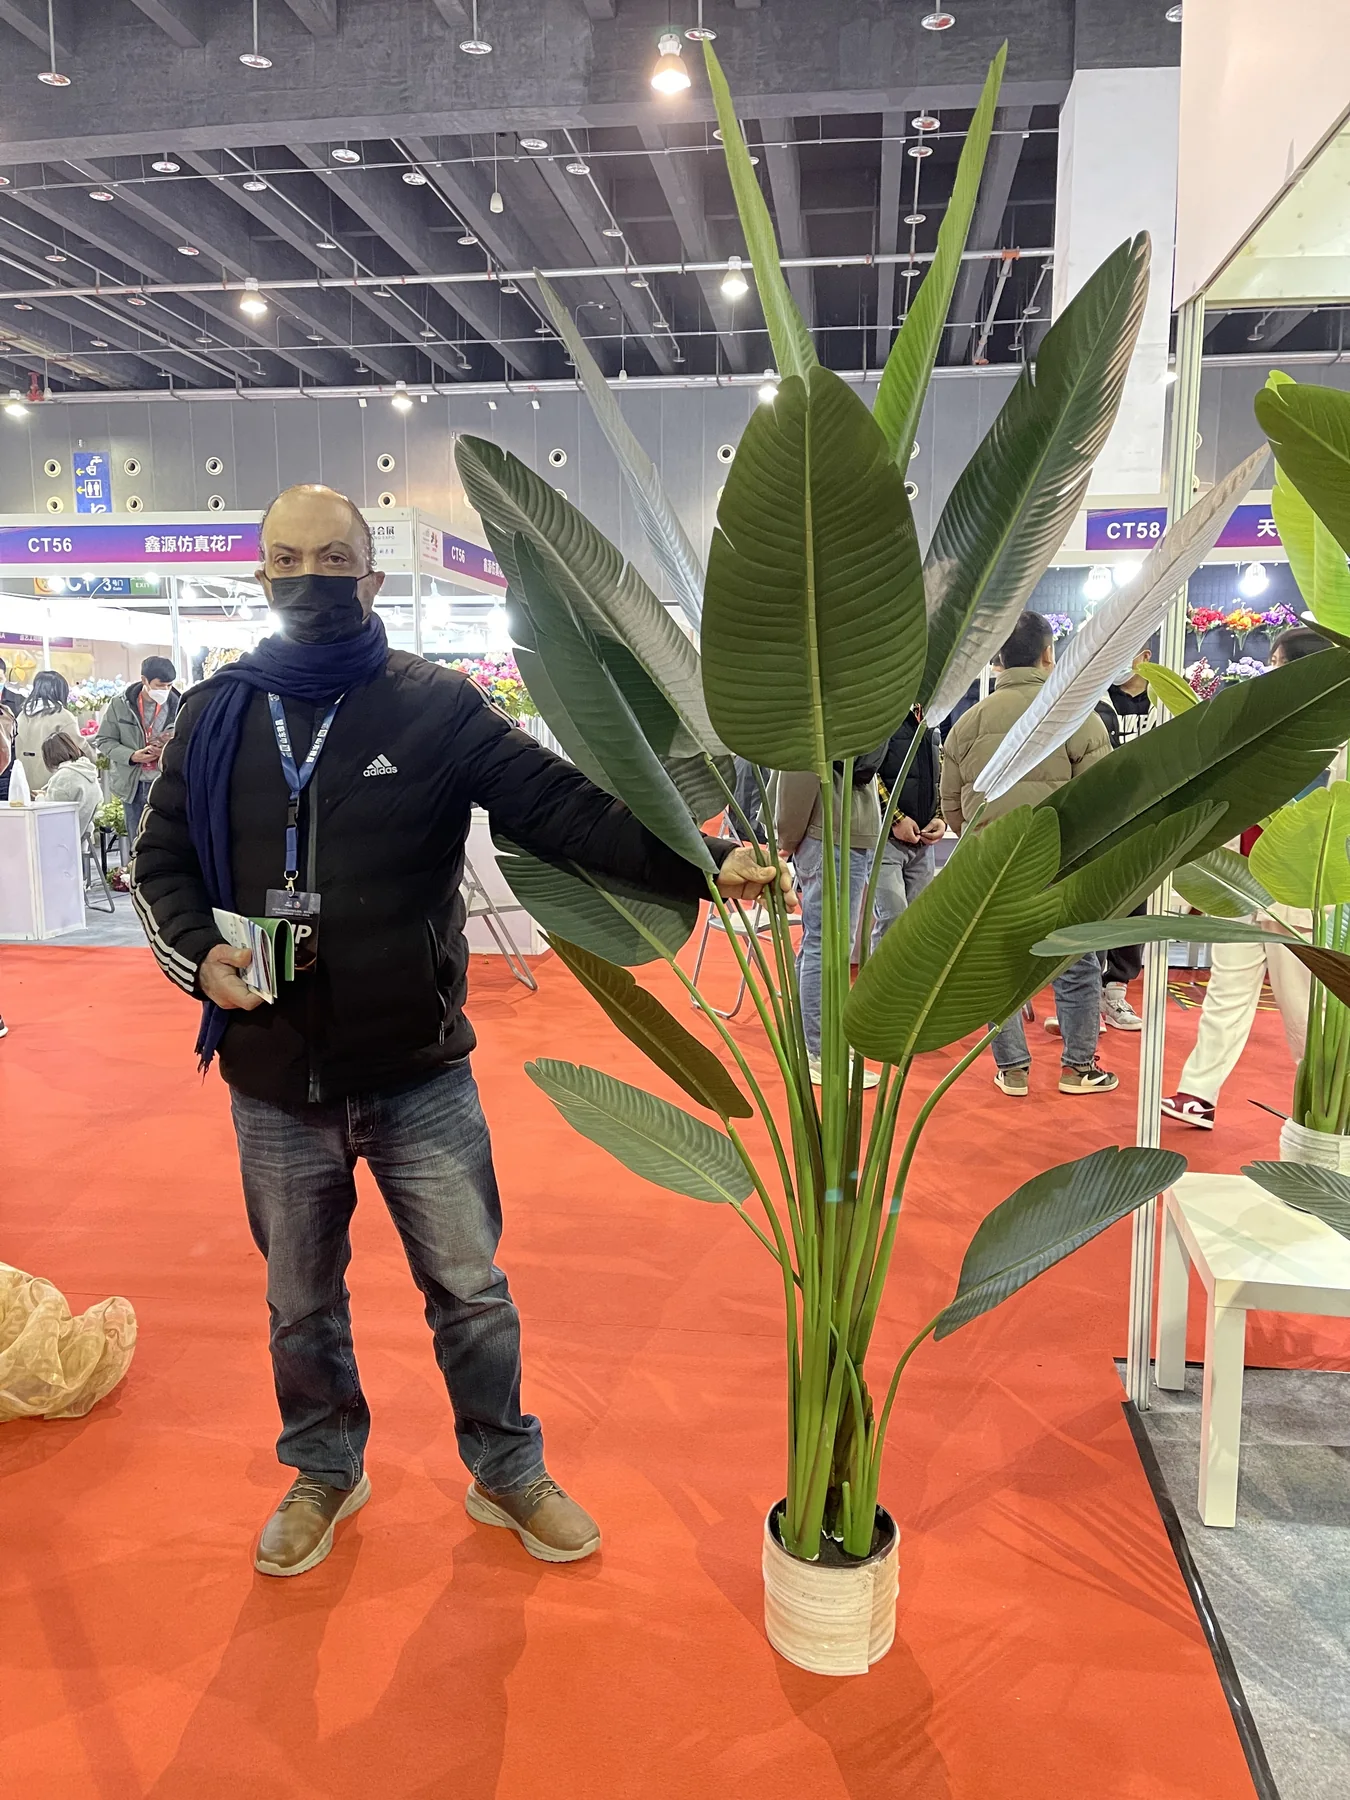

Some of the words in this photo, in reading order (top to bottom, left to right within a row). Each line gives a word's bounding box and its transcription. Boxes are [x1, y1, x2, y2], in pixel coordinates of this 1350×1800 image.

[1257, 518, 1280, 537] 天
[27, 537, 73, 553] CT56
[144, 534, 243, 553] 鑫源仿真花厂
[451, 546, 466, 563] CT56
[362, 765, 398, 777] adidas
